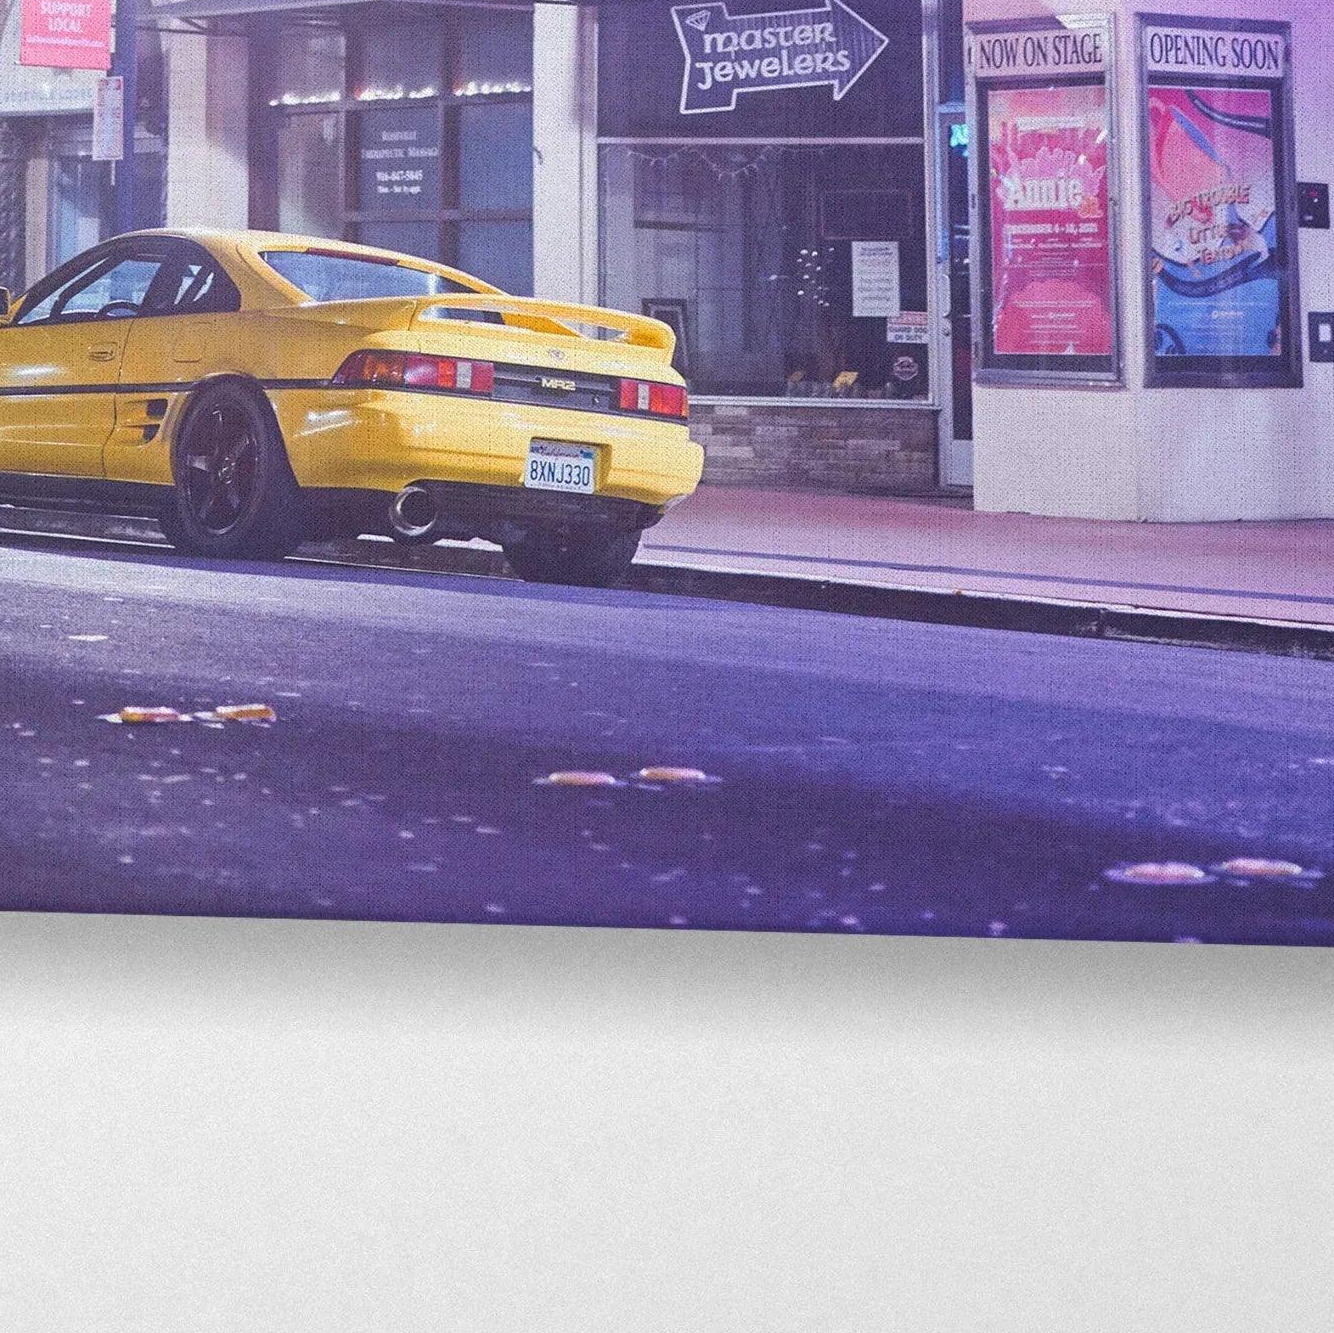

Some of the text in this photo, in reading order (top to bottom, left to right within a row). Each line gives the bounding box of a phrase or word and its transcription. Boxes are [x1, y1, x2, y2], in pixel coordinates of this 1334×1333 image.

[40, 1, 93, 17] SUPPORT
[48, 18, 84, 34] LOCAL
[979, 33, 1103, 68] NOW ON STAGE
[1150, 32, 1280, 70] OPENING SOON
[1004, 172, 1084, 211] Annie
[541, 378, 576, 391] MR2
[531, 460, 590, 486] 8XNJ330
